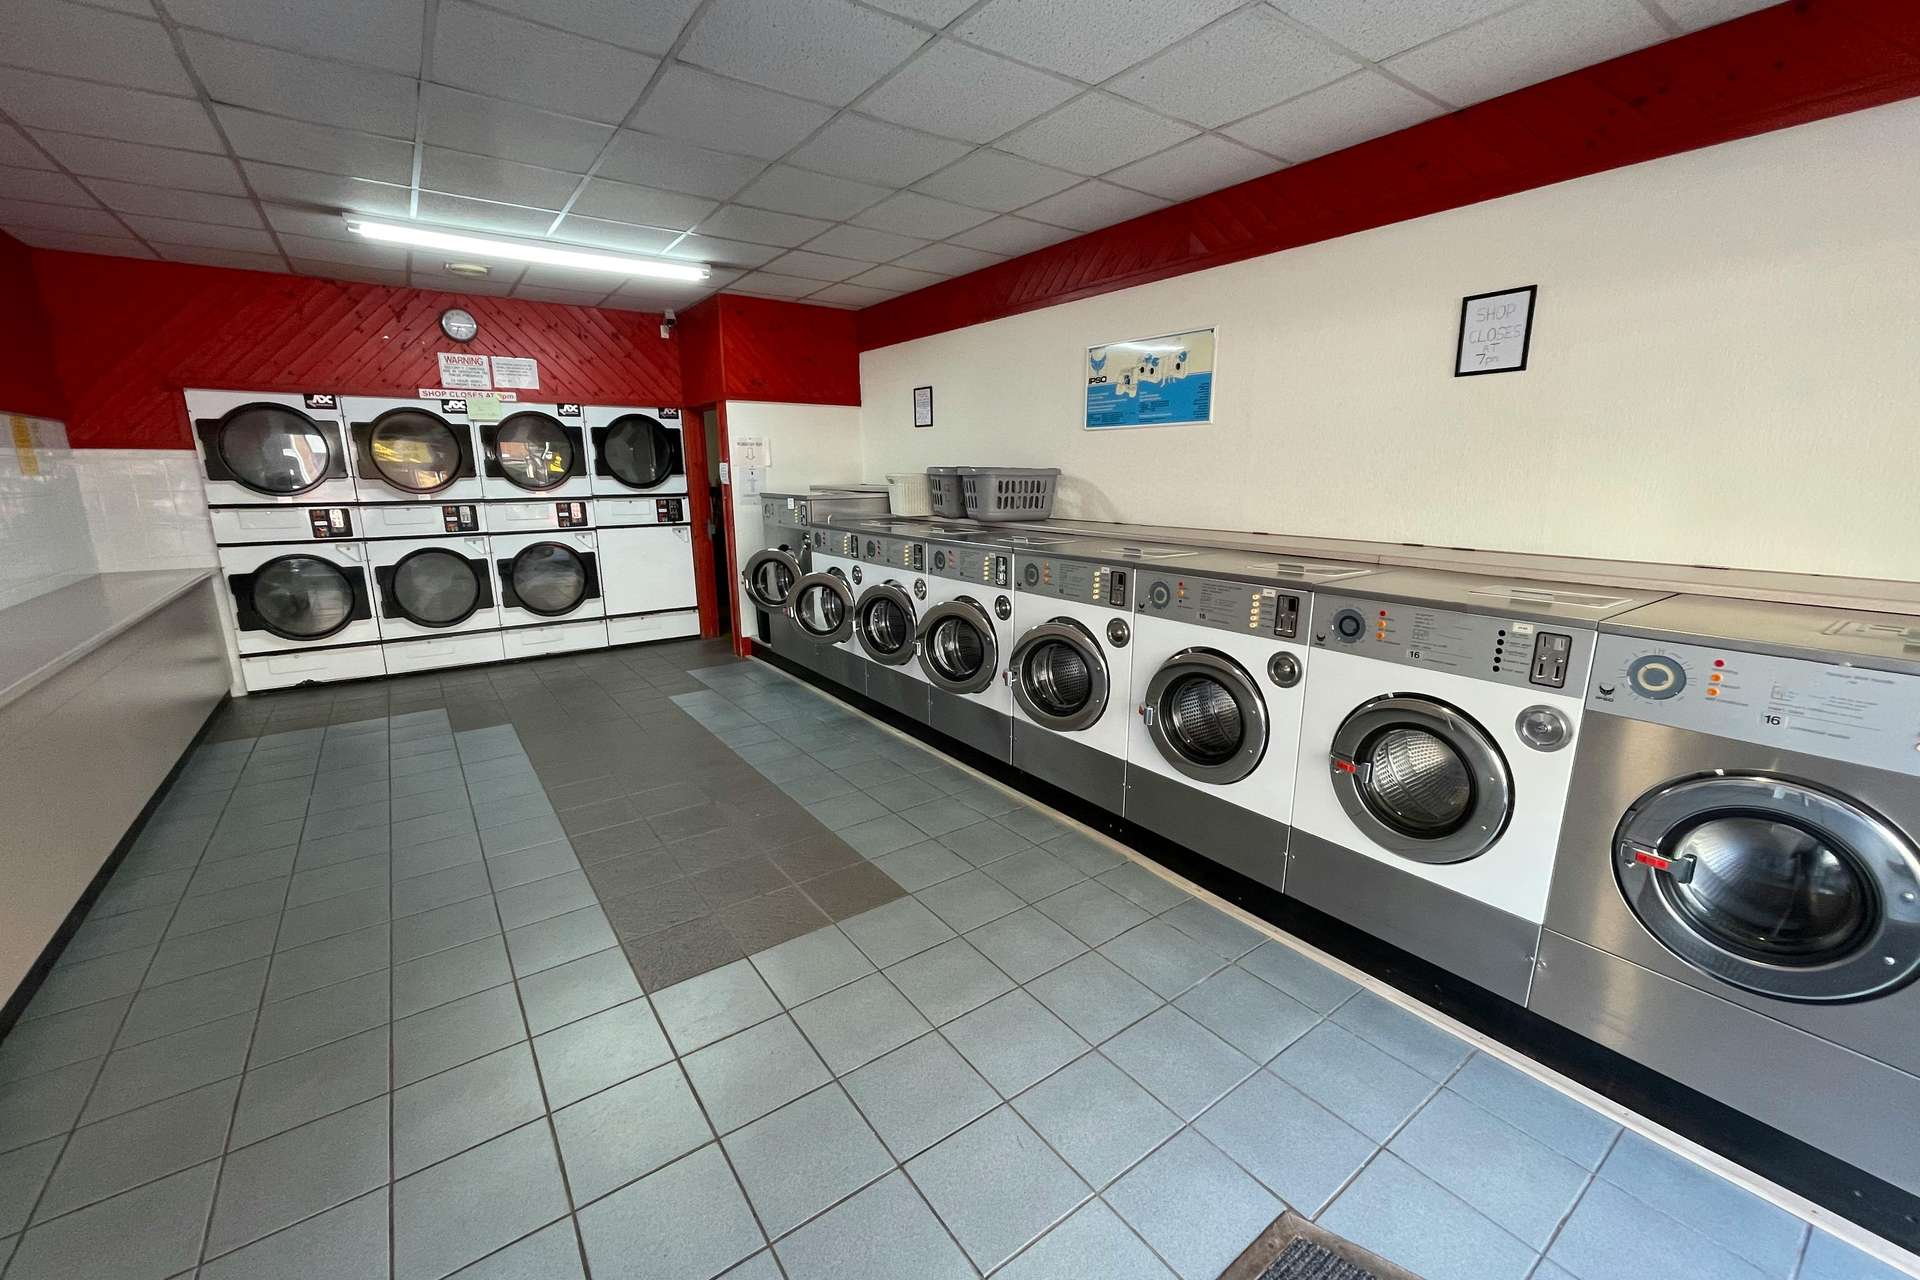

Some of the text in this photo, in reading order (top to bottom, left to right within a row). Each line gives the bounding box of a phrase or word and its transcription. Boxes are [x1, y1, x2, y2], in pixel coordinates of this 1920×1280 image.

[1475, 303, 1516, 321] SHOP
[1469, 324, 1522, 344] CLOSES
[443, 355, 484, 366] WARNING
[1410, 651, 1420, 659] 16
[1764, 715, 1781, 726] 16
